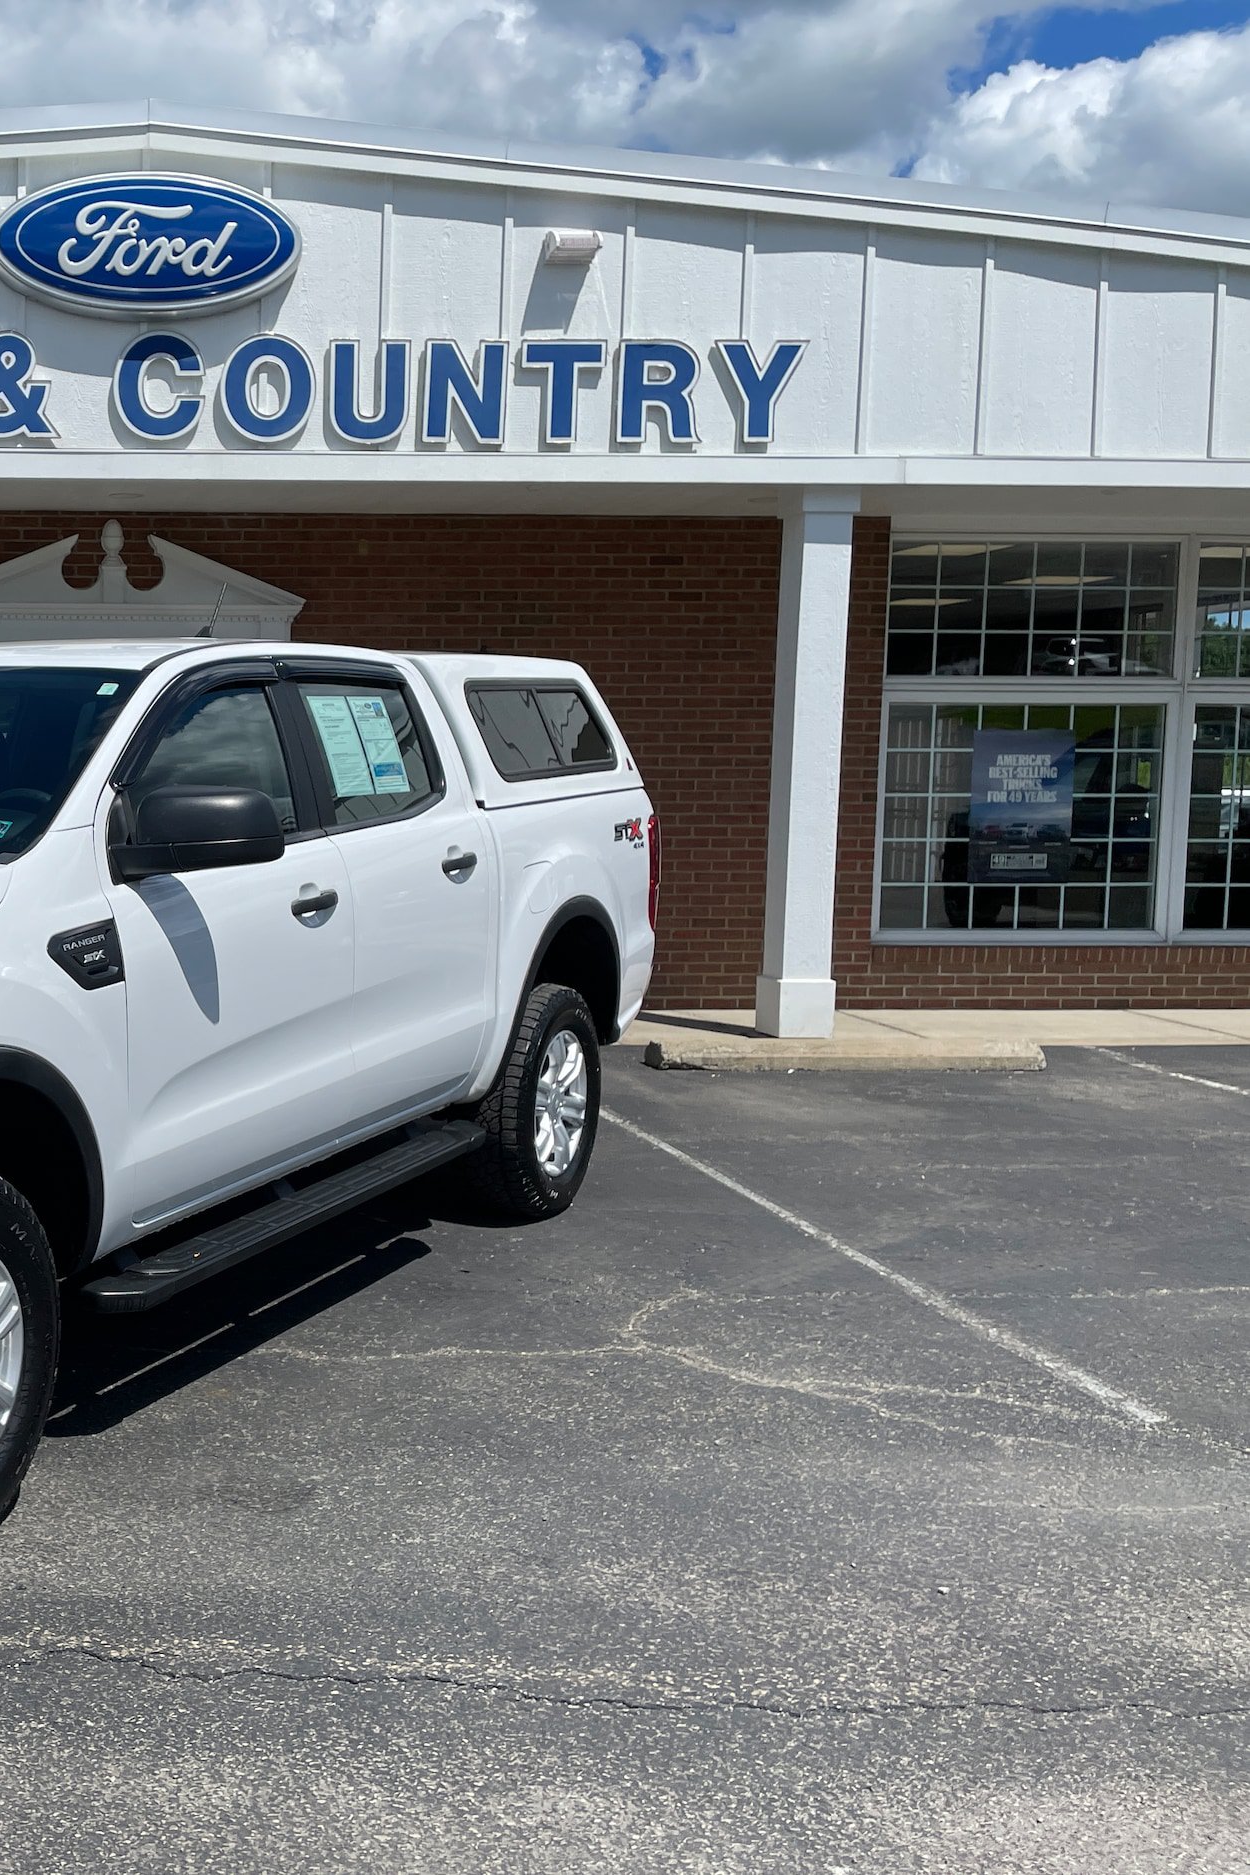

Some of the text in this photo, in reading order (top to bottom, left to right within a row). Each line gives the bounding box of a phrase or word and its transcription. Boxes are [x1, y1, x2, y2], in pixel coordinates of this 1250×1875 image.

[58, 200, 238, 277] Ford
[114, 330, 812, 445] COUNTRY
[996, 753, 1052, 767] AMERICA'S
[987, 790, 1058, 803] FOR 49 YEARS
[614, 817, 644, 842] STX
[62, 934, 106, 952] RANGER
[83, 949, 106, 964] STX
